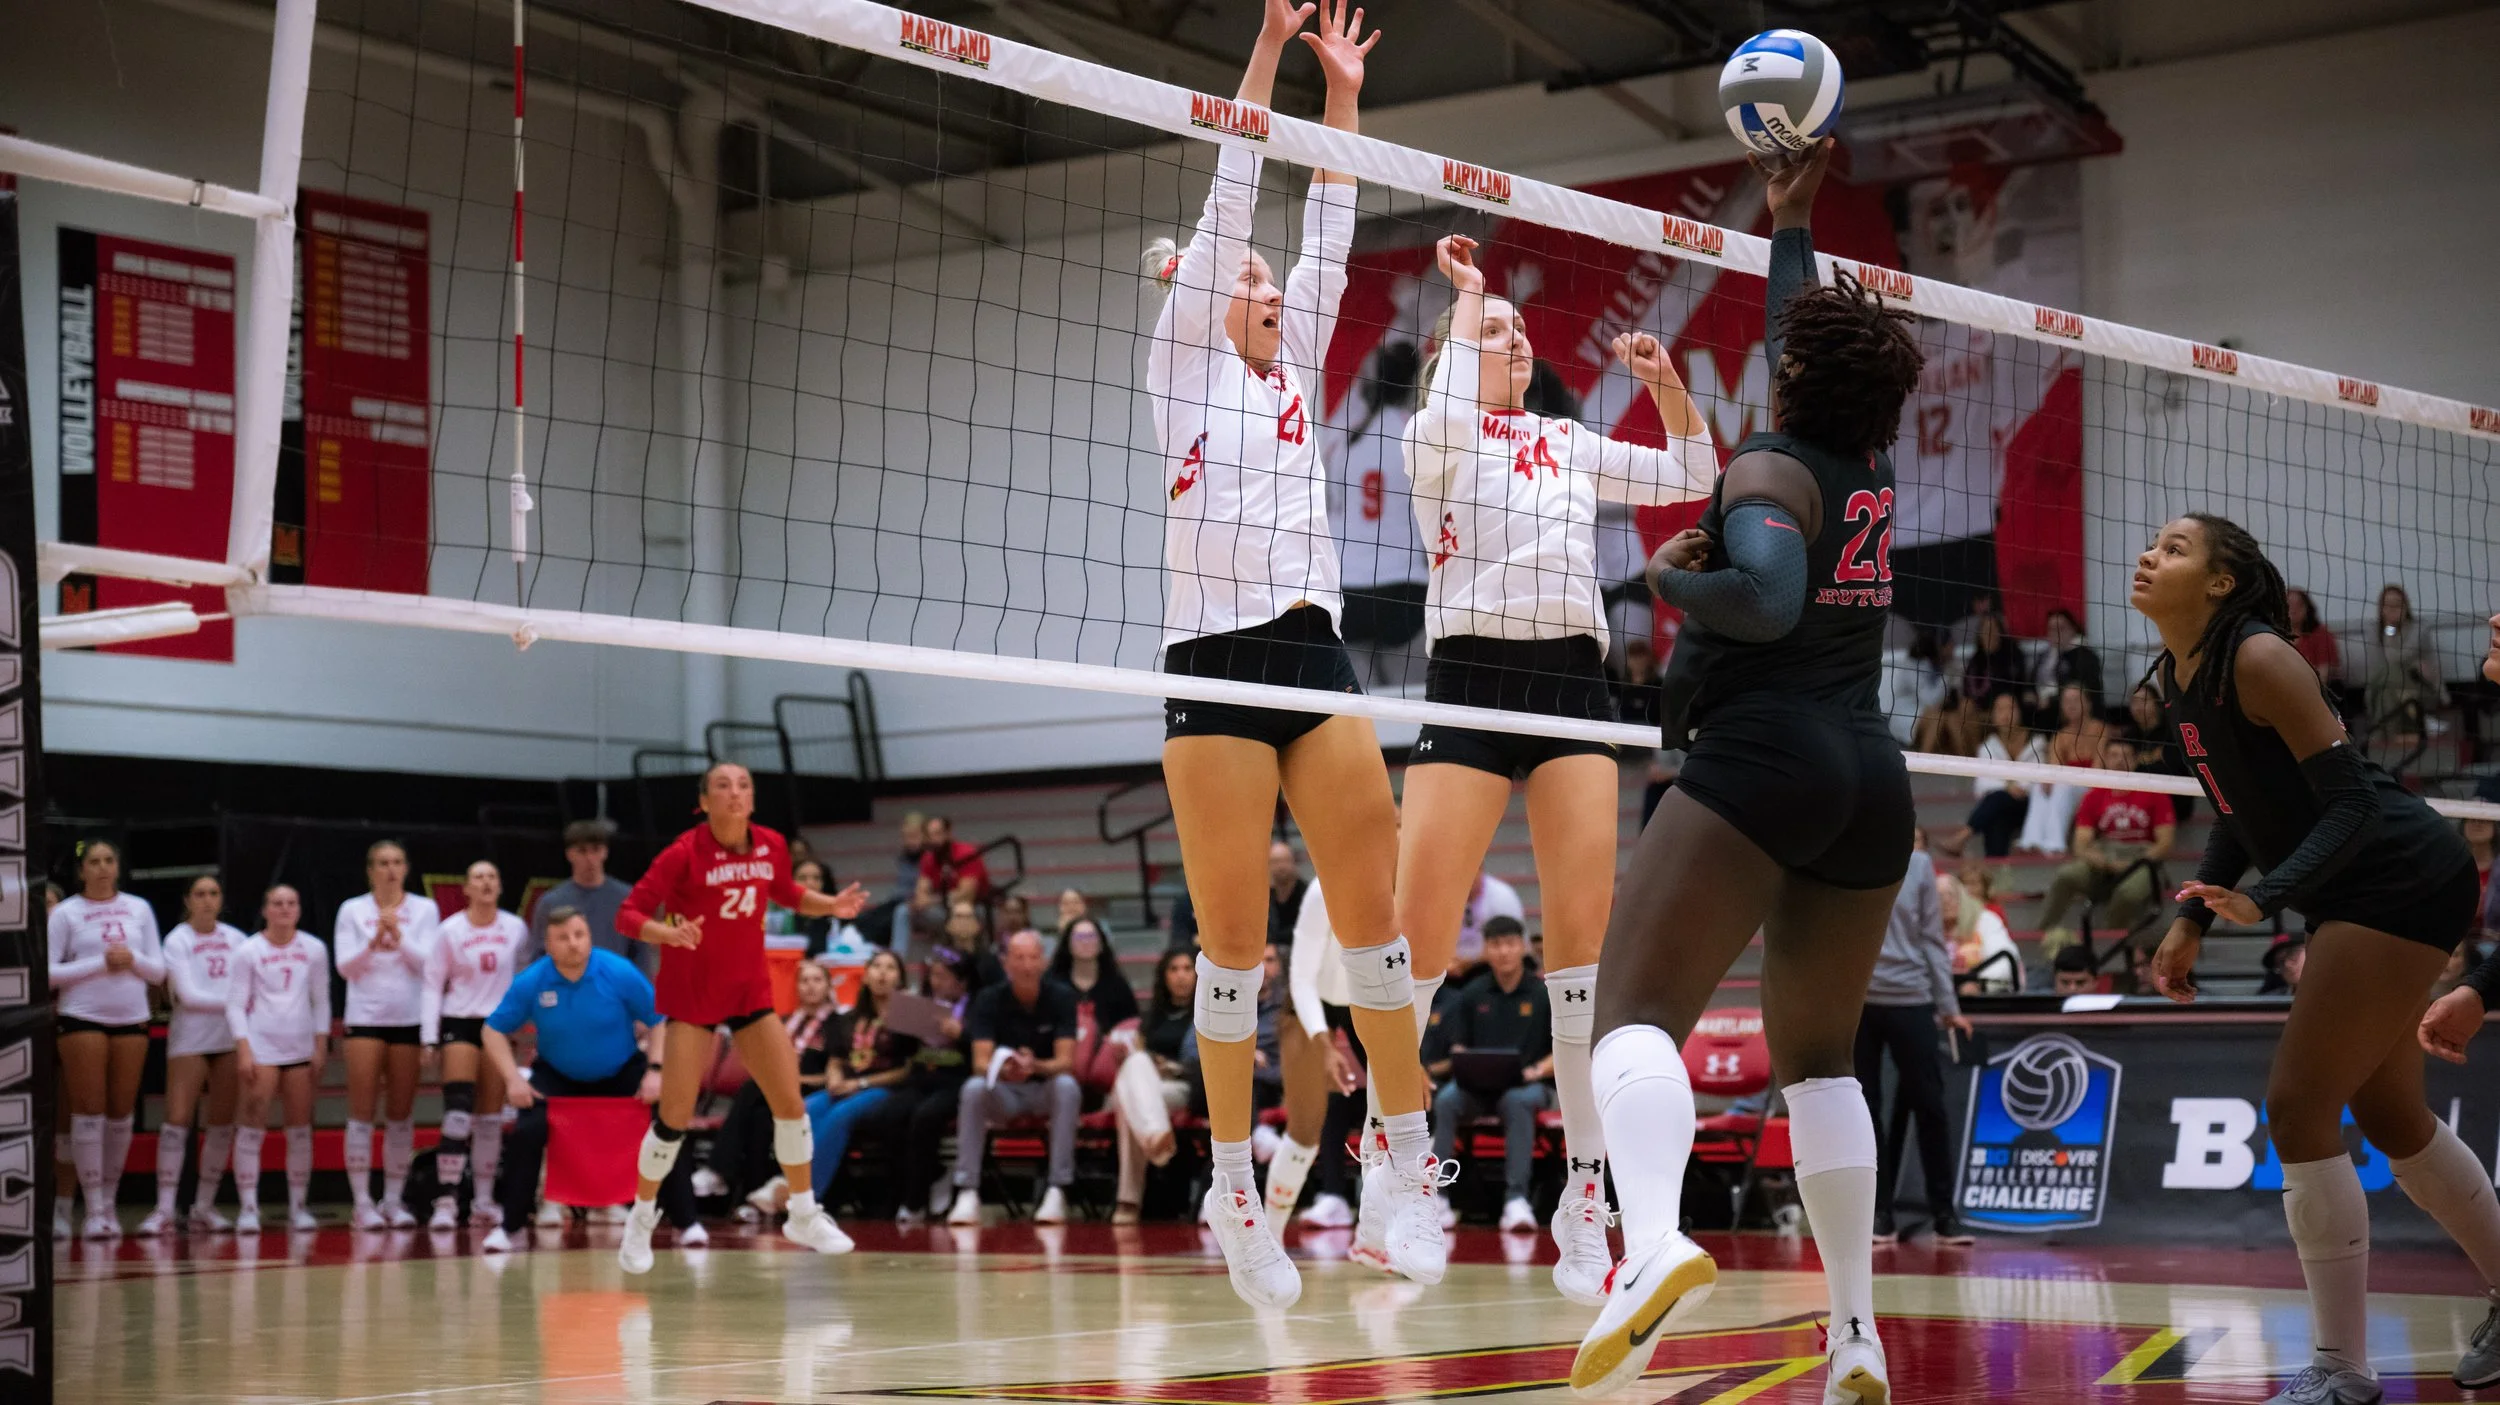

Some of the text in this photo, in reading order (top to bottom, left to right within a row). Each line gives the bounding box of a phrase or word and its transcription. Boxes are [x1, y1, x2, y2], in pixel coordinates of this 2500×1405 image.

[900, 11, 991, 62] MARYLAND
[1191, 92, 1270, 136] MARYLAND
[1766, 117, 1806, 151] molte
[1443, 159, 1512, 199] MARYLAND
[1663, 215, 1724, 251] MARYLAND
[1858, 264, 1913, 296] MARYLAND
[2034, 306, 2084, 336] MARYLAND
[2192, 343, 2238, 372] MARYLAND
[62, 284, 94, 475] VOLLEYBALL
[1916, 403, 1953, 458] 12
[1362, 470, 1384, 521] 9
[1834, 486, 1894, 583] 22
[2179, 723, 2207, 756] R
[2197, 763, 2233, 814] 1
[720, 886, 757, 919] 24
[2020, 1150, 2098, 1167] DISCOVER
[1969, 1168, 2097, 1186] VOLLEYBALL
[1963, 1186, 2096, 1211] CHALLENGE
